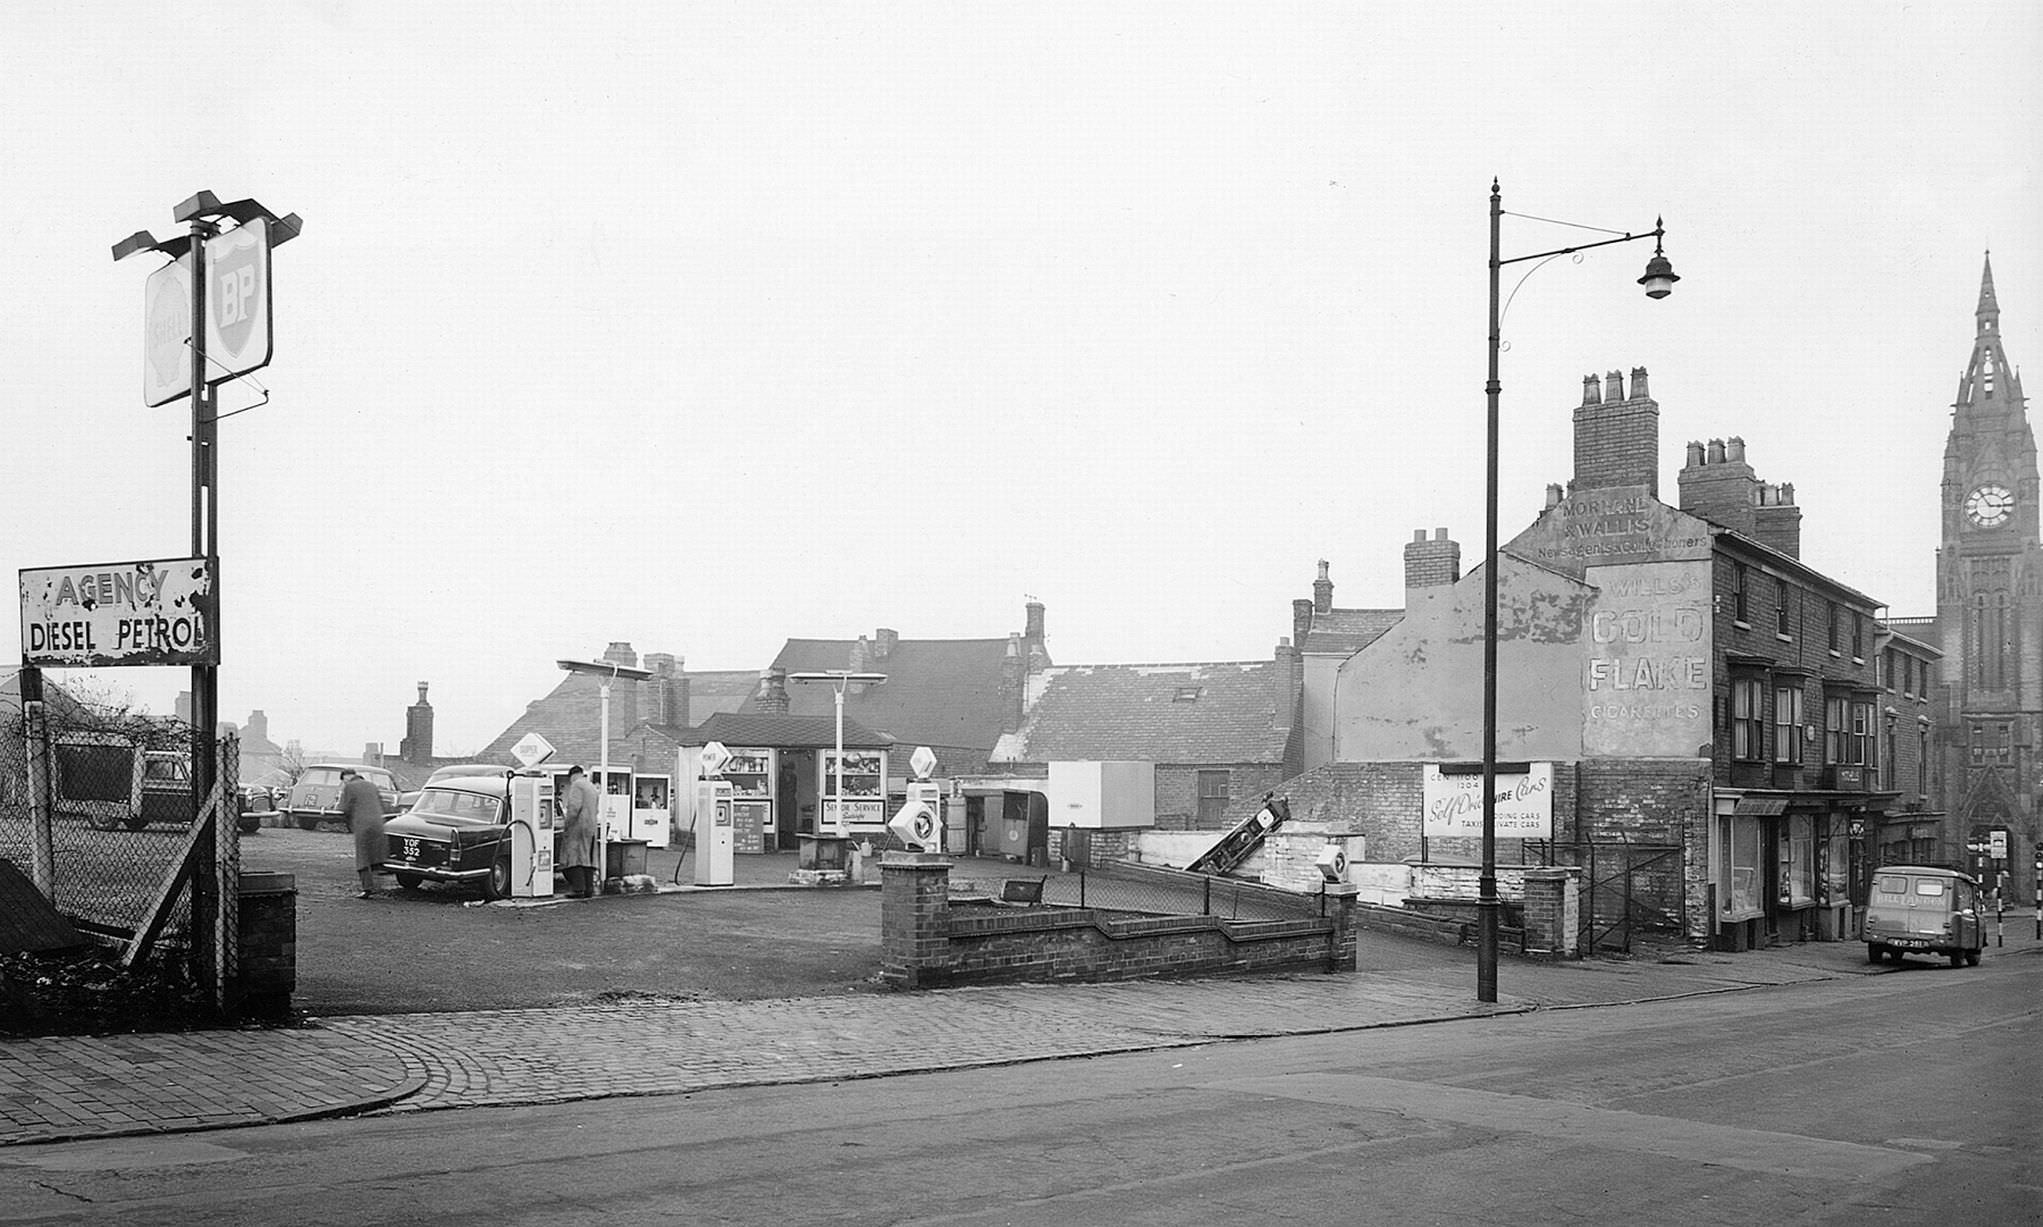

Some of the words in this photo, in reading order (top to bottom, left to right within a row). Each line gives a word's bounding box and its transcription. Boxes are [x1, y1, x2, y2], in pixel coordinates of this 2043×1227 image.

[220, 264, 255, 329] BP
[56, 570, 168, 606] AGENCY
[30, 621, 96, 651] DIESEL
[1592, 608, 1703, 644] GOLD
[1589, 656, 1707, 691] FLAKE
[1516, 776, 1546, 801] Cars
[854, 802, 881, 812] SERVICE
[403, 847, 420, 857] 352
